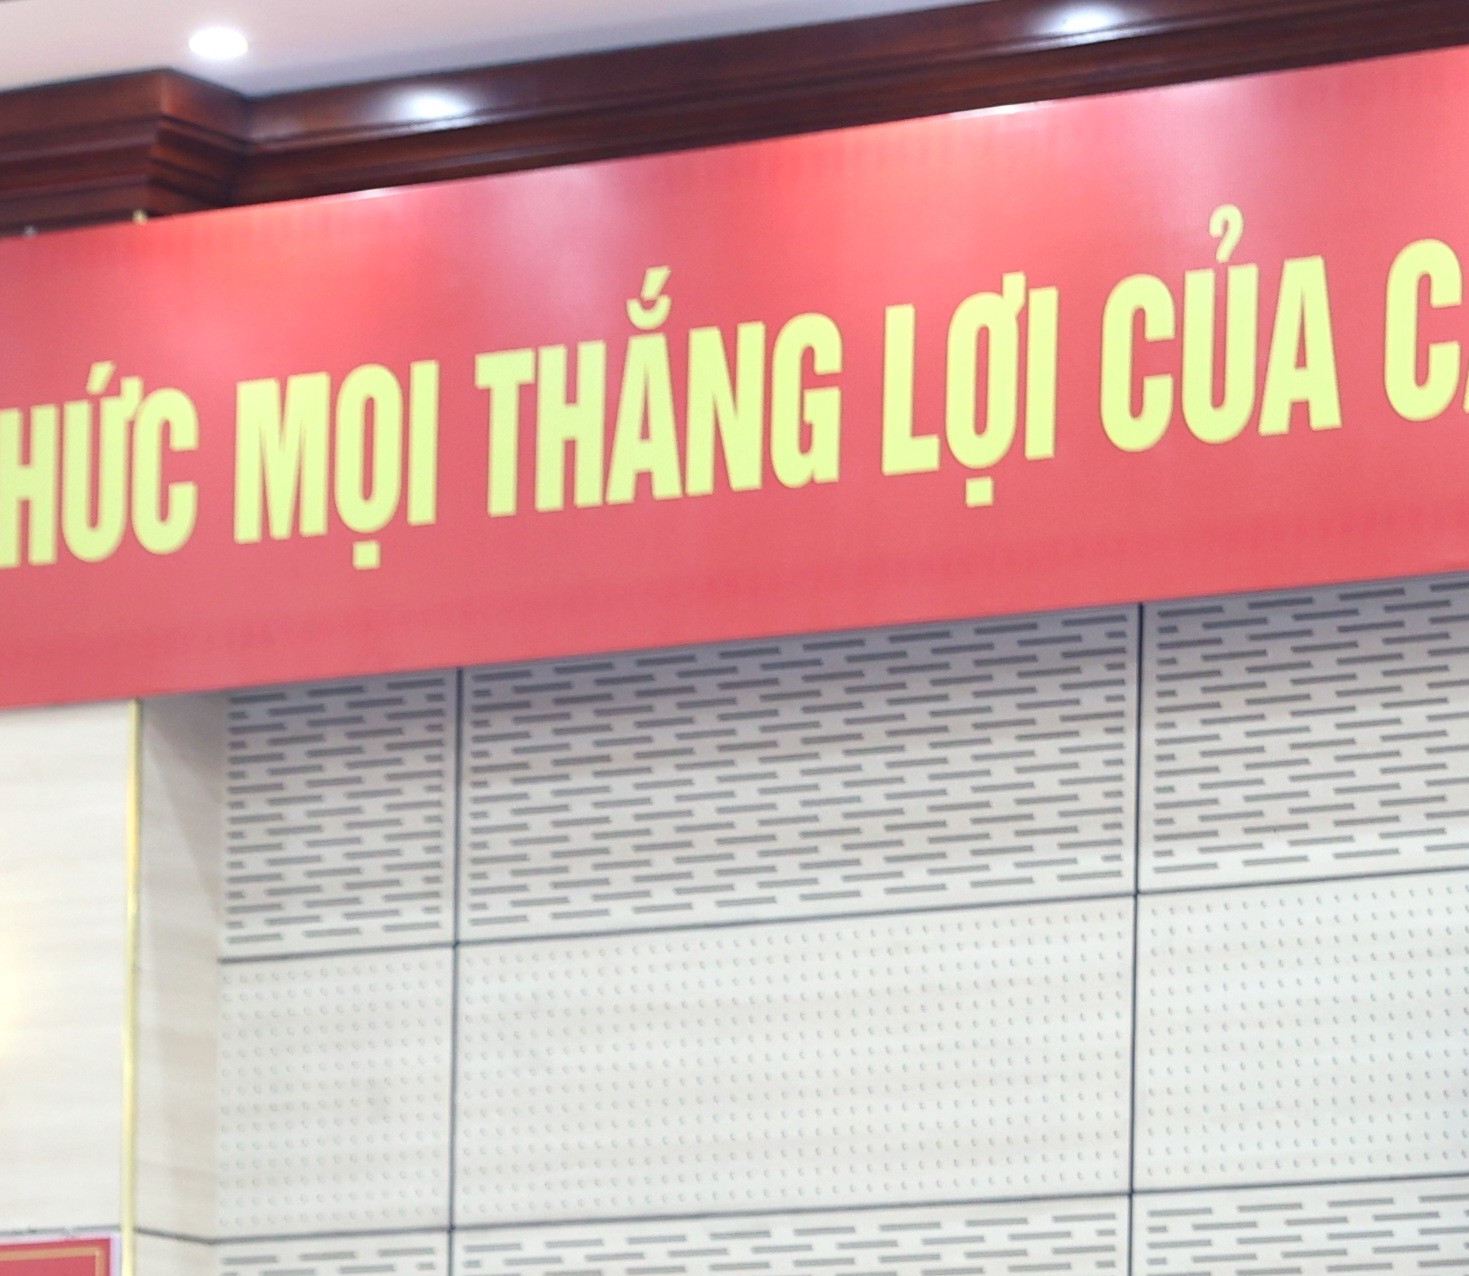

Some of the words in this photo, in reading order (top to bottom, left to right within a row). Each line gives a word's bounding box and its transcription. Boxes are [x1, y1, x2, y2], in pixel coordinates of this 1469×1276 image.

[234, 359, 438, 570] MỌI
[475, 266, 844, 517] THẮNG
[881, 271, 1059, 508] LỢI
[1100, 205, 1342, 452] CỦA
